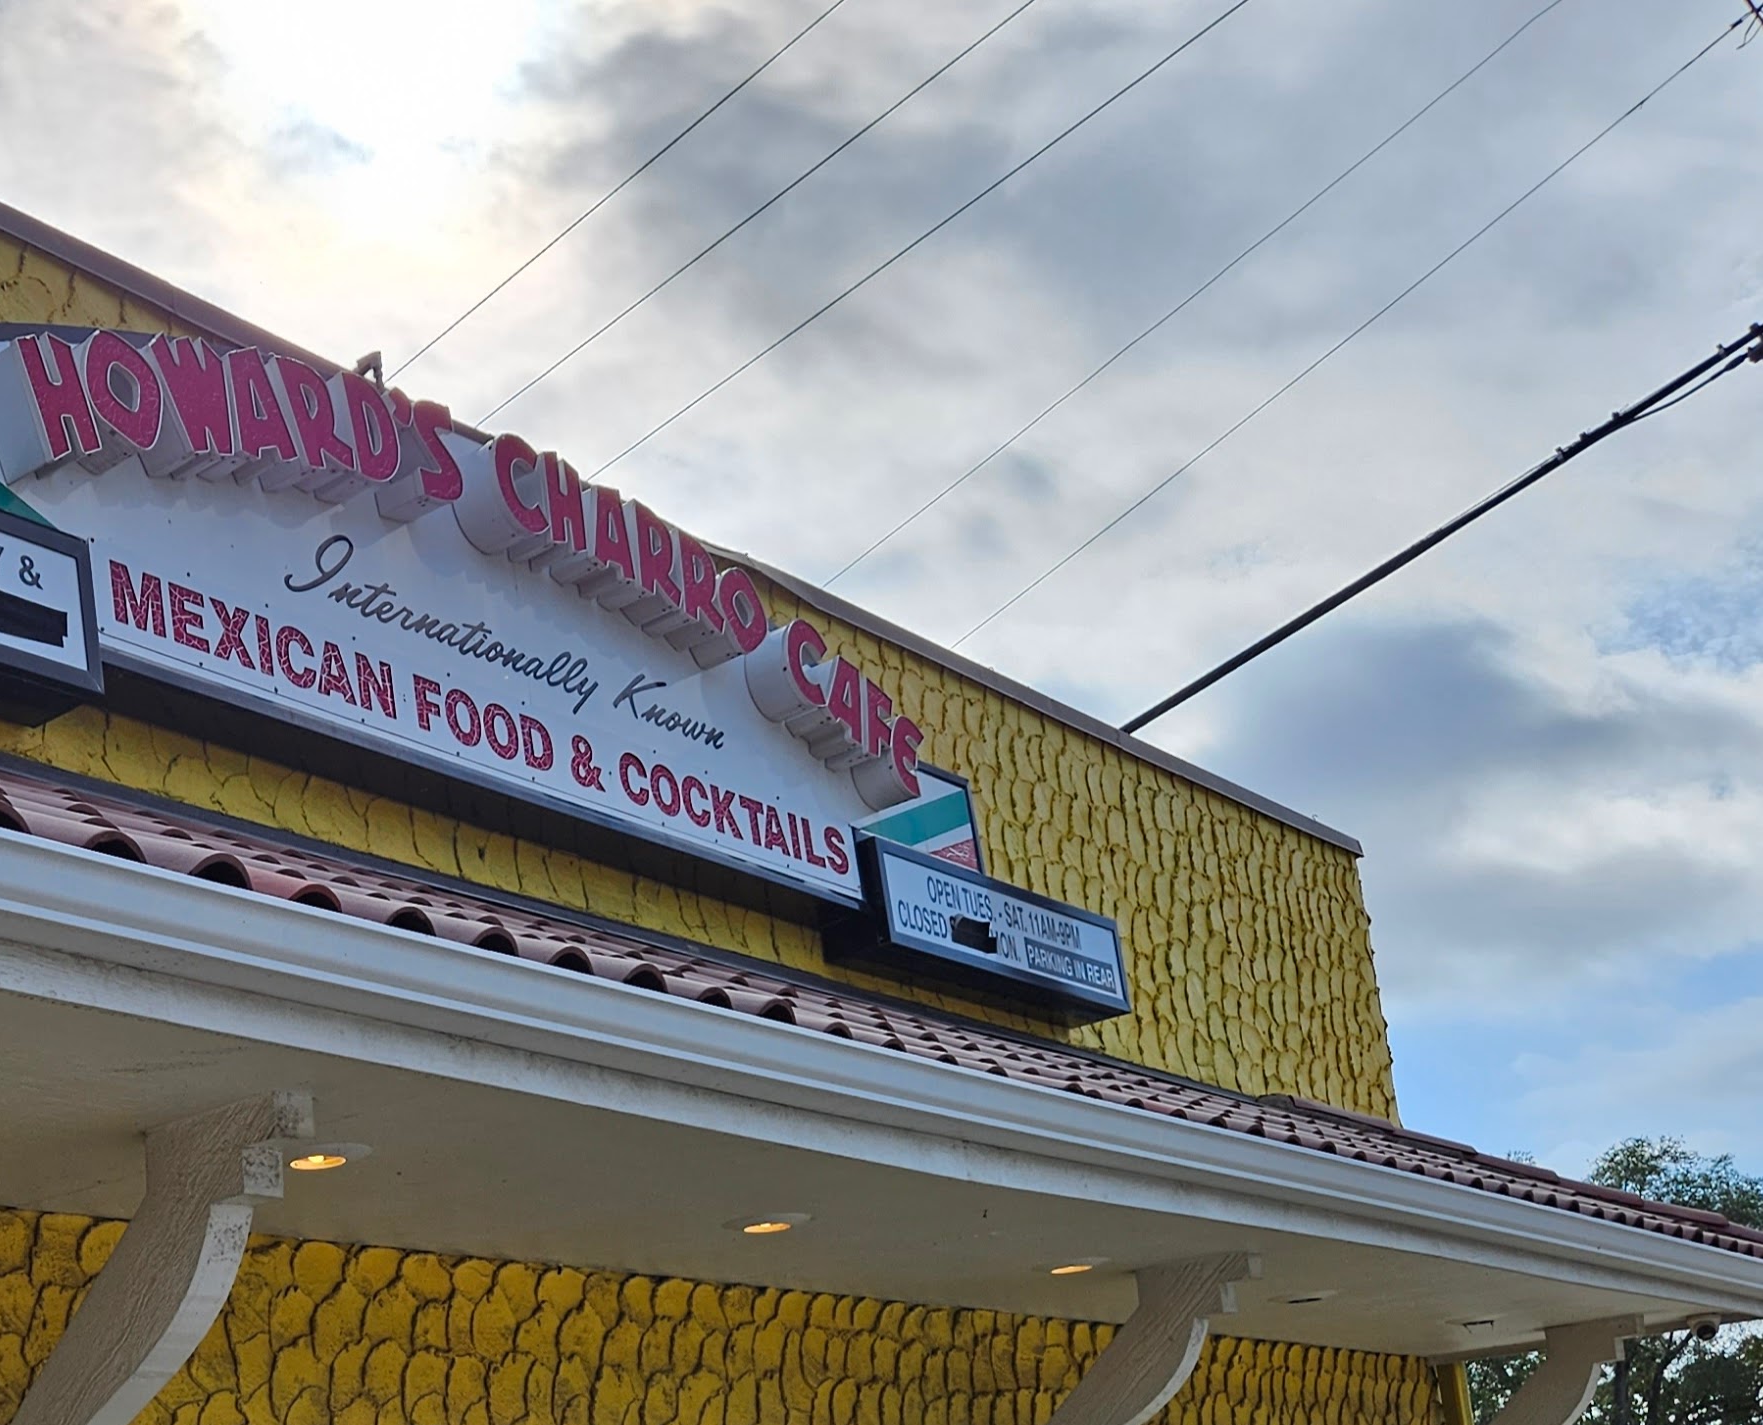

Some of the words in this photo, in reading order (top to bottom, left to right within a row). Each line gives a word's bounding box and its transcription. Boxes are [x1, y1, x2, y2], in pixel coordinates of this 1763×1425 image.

[17, 329, 464, 502] HOWARD'S
[493, 433, 768, 654] CHARRO
[787, 619, 924, 797] CAFE
[18, 554, 44, 591] &
[108, 559, 398, 720] MEXICAN
[412, 673, 554, 771] FOOD
[571, 734, 606, 793] &
[619, 749, 849, 876] COCKTAILS
[284, 534, 599, 715] Internationally
[613, 674, 725, 751] Known
[897, 900, 948, 940] CLOSED
[1027, 944, 1074, 977] PARKING
[1073, 960, 1086, 981] IN
[1086, 963, 1115, 989] REAR
[926, 875, 961, 912] OPEN
[961, 888, 996, 923] TUES.
[1003, 902, 1028, 934] SAT.
[1028, 911, 1082, 950] 11AM-9PM
